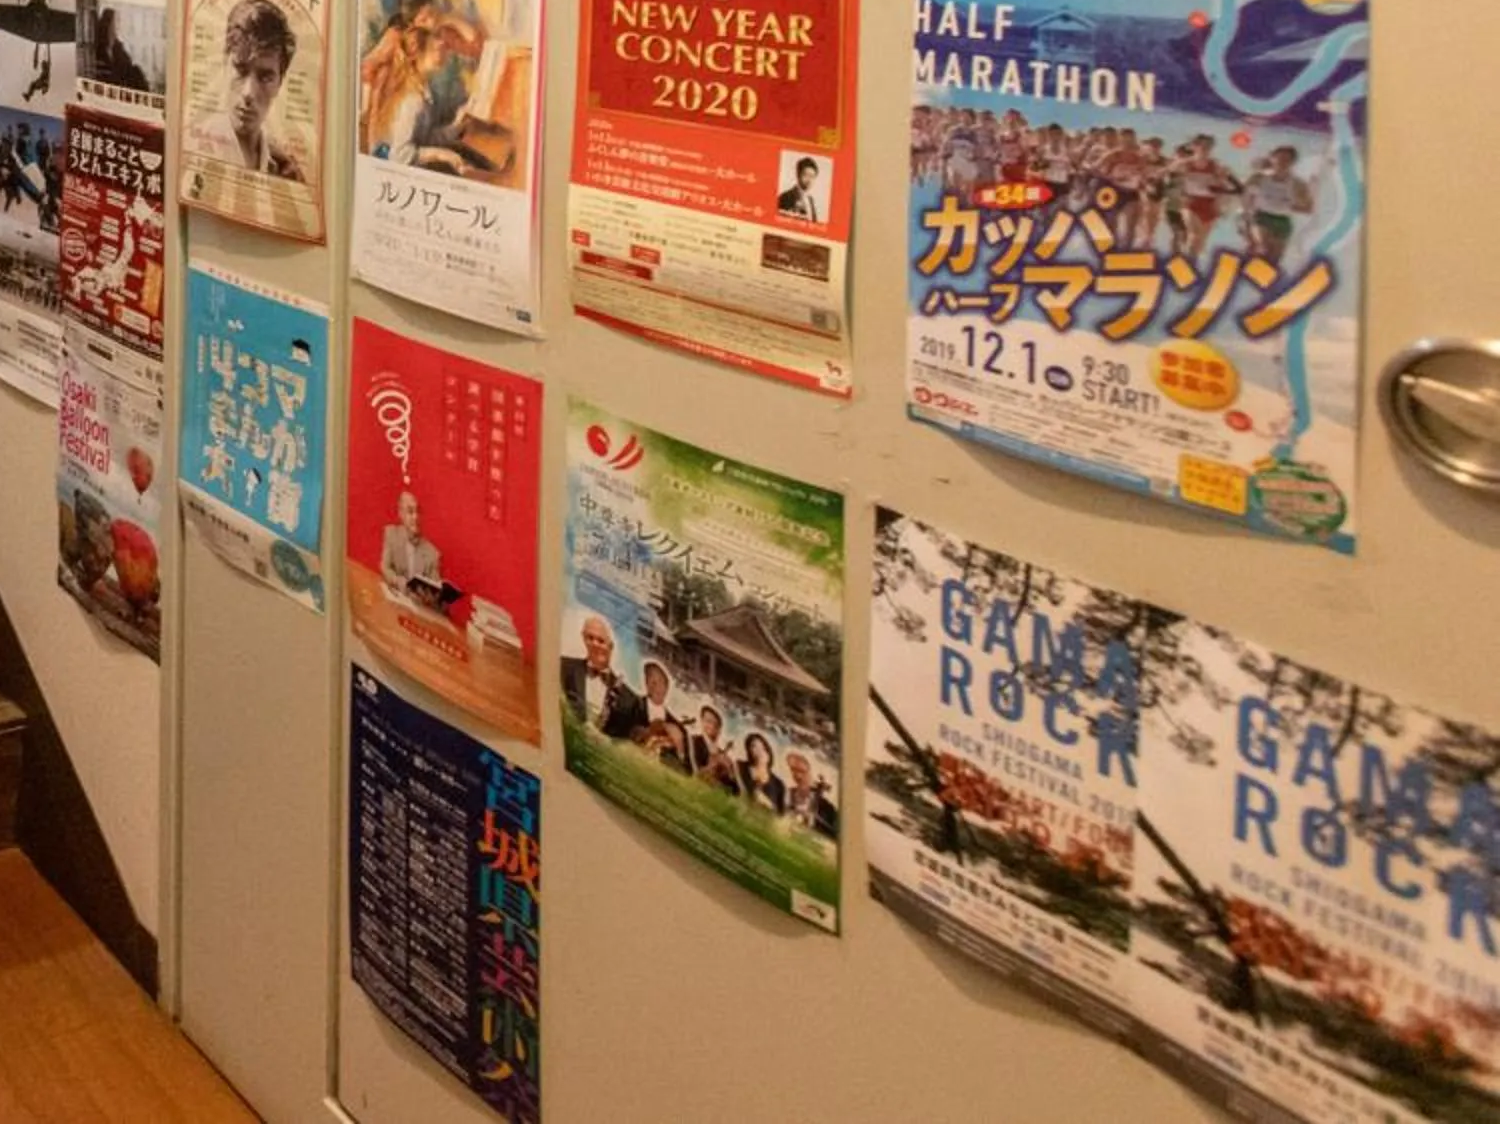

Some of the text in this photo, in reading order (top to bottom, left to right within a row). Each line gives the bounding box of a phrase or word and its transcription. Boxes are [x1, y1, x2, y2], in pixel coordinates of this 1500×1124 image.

[712, 7, 815, 48] YEAR
[614, 30, 806, 82] CONCERT
[912, 49, 1157, 113] MARATHON
[652, 74, 759, 122] 2020
[916, 186, 1118, 278] カッパ
[921, 252, 1333, 341] ハーフ マラソン
[961, 325, 1037, 386] 12.1
[1081, 355, 1131, 384] 9:30
[61, 369, 97, 412] Osaki
[1081, 380, 1161, 414] START!
[59, 429, 113, 475] Festival
[939, 578, 1138, 714] GAMA
[938, 724, 986, 762] ROCK
[991, 751, 1082, 806] FESTIVAL
